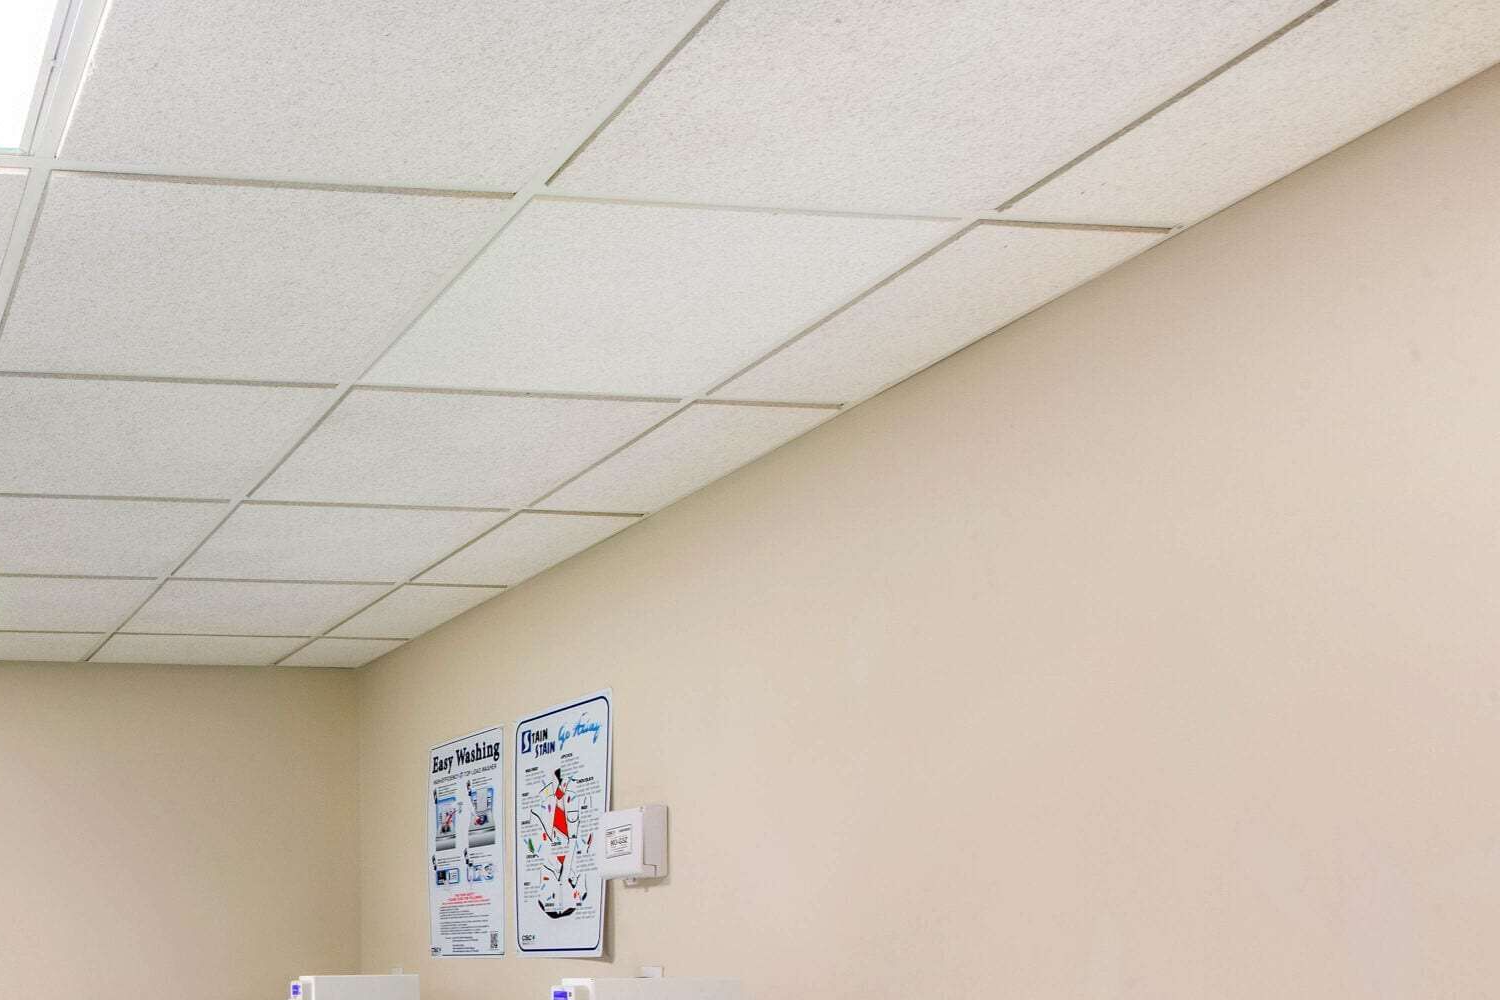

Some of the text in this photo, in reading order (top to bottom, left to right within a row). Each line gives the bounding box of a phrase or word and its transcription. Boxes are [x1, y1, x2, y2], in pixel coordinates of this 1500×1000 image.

[432, 742, 500, 774] Easy Washing
[535, 741, 556, 758] STAIN
